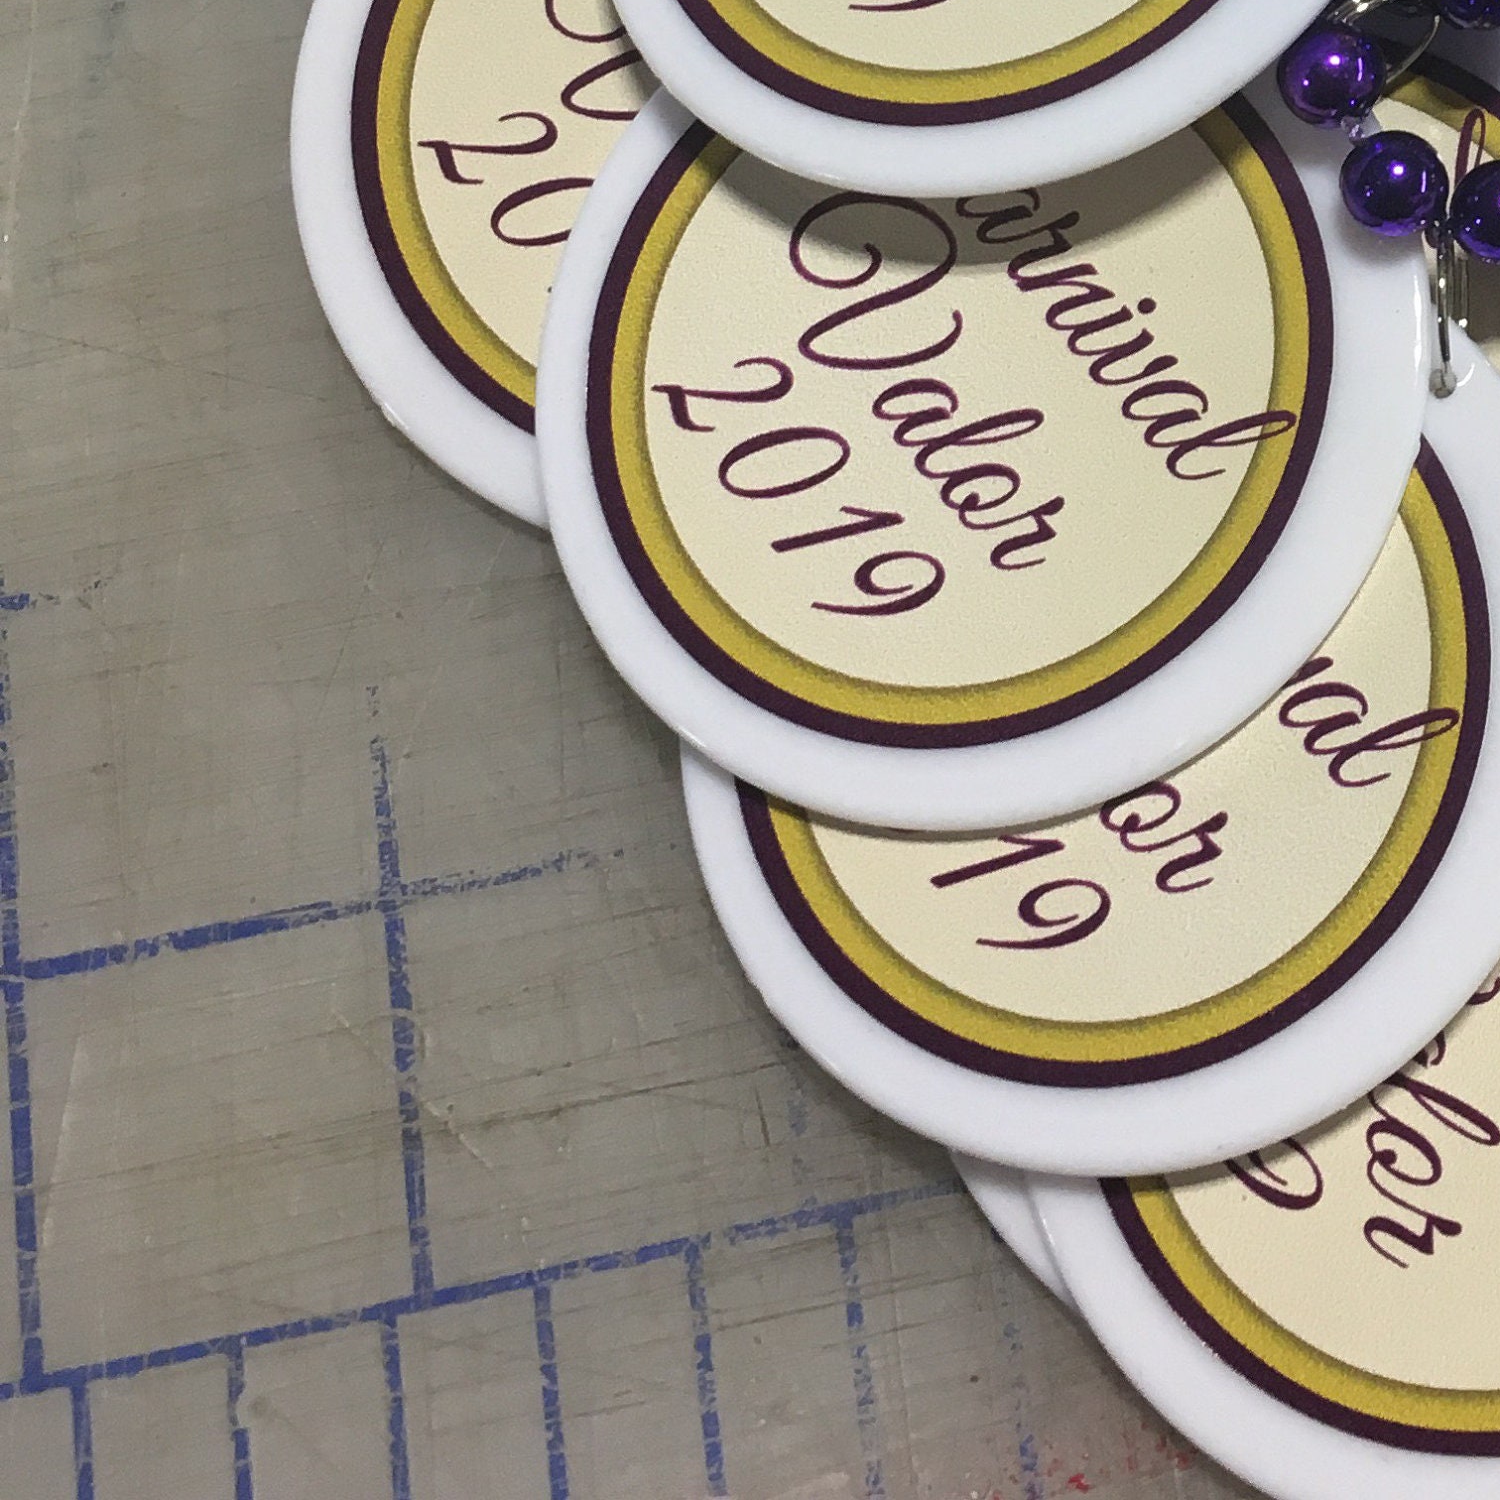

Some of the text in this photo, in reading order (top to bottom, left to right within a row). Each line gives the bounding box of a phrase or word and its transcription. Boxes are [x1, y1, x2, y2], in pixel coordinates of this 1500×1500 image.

[418, 111, 596, 247] 20
[789, 192, 1065, 570] Valor
[955, 186, 1297, 480] arnival
[651, 357, 945, 617] 2019
[929, 834, 1112, 951] 19
